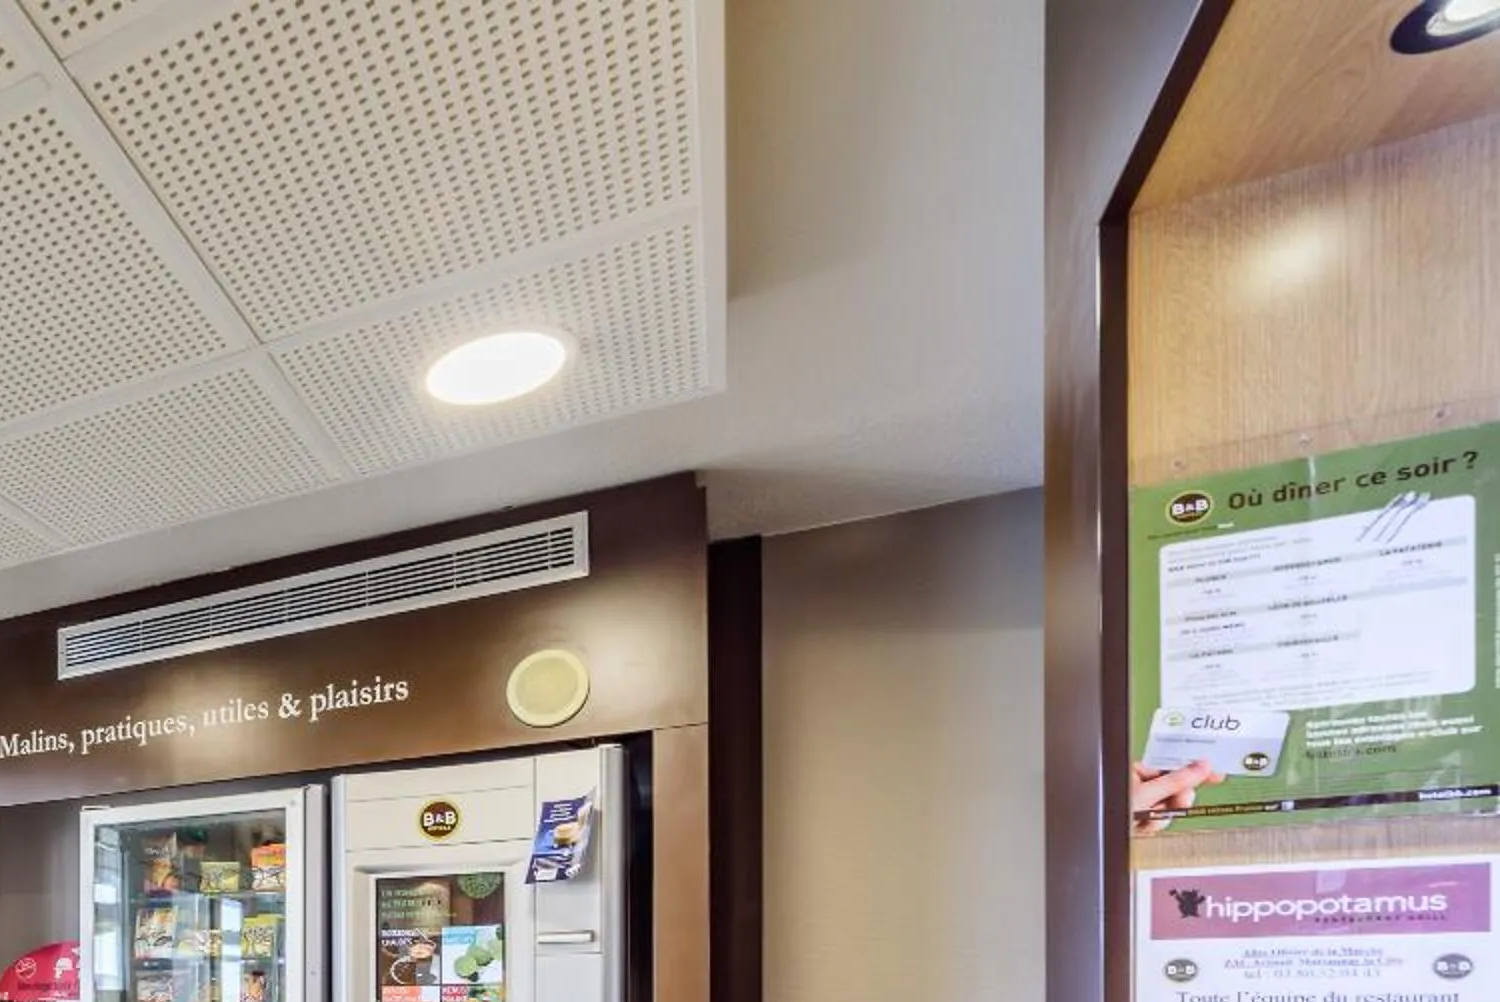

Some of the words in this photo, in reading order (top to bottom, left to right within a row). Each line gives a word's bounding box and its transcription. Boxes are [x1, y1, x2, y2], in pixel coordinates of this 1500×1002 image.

[1228, 489, 1263, 511] Où
[1272, 477, 1347, 504] dîner
[1355, 470, 1388, 488] ce
[1396, 457, 1457, 482] soir
[1462, 450, 1479, 470] ?
[1172, 499, 1209, 516] B&B
[80, 715, 196, 756] pratiques,
[202, 697, 270, 727] utiles
[277, 692, 302, 719] &
[308, 675, 410, 723] plaisirs
[1191, 714, 1242, 731] club
[423, 811, 457, 827] B&B
[1205, 894, 1449, 923] hippopotamus
